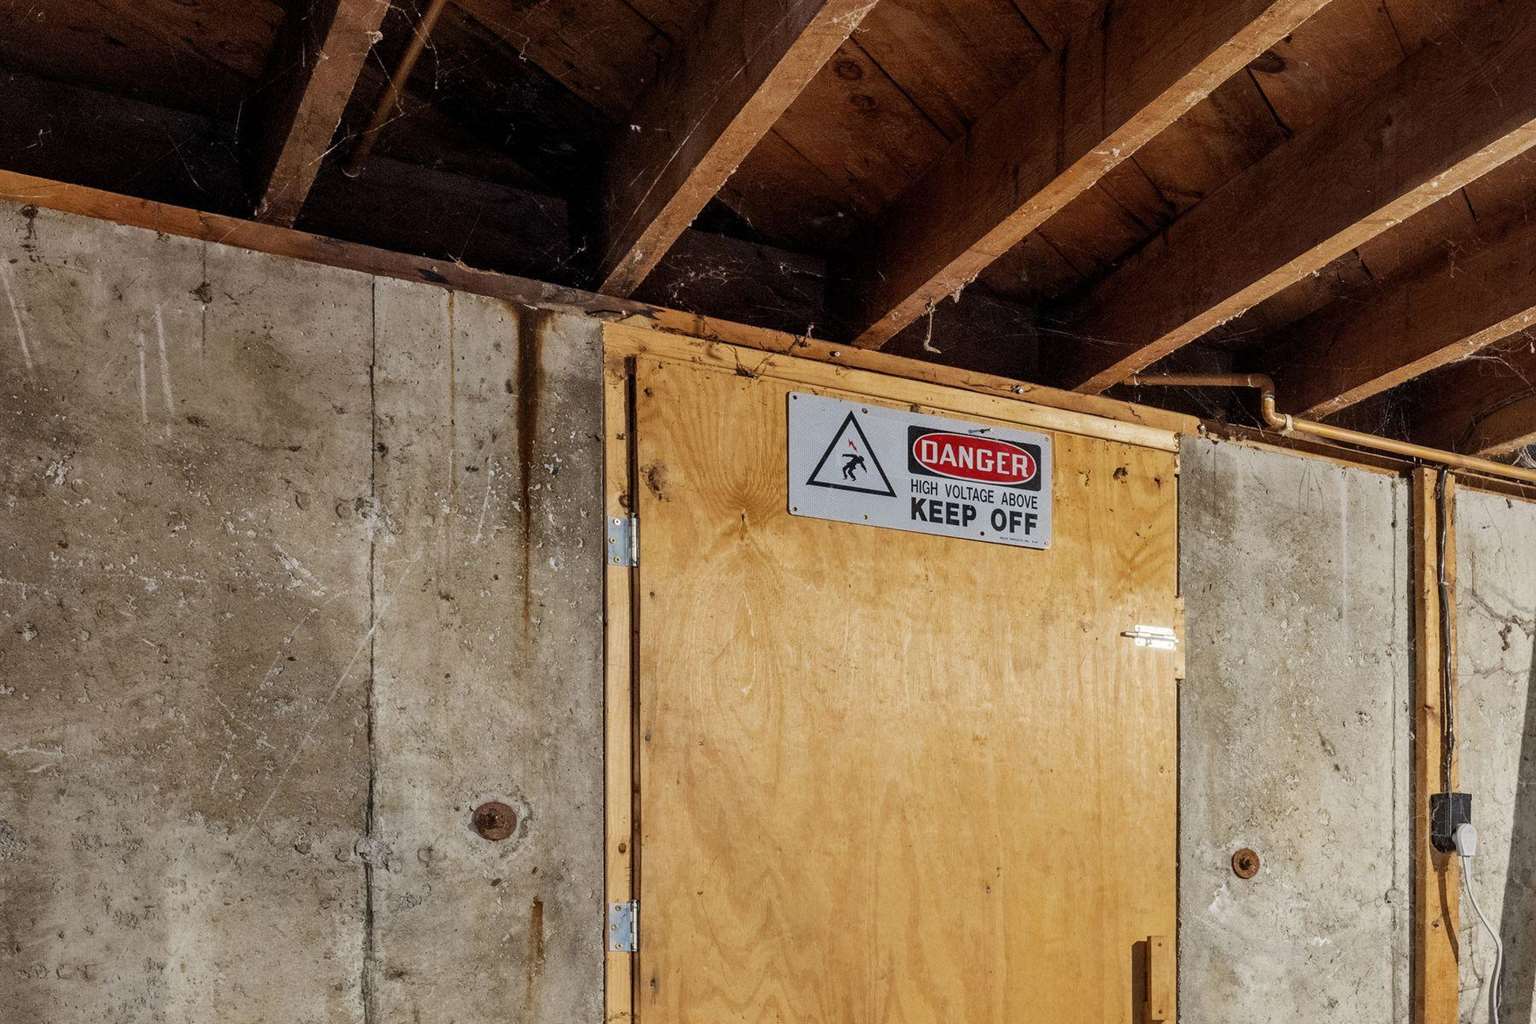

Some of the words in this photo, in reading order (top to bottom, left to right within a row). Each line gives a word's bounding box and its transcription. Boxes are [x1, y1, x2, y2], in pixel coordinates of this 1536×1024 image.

[922, 440, 1028, 477] DANGER
[910, 479, 938, 497] HIGH
[945, 484, 995, 503] VOLTAGE
[1001, 492, 1037, 508] ABOVE
[911, 497, 977, 527] KEEP
[991, 508, 1038, 535] OFF
